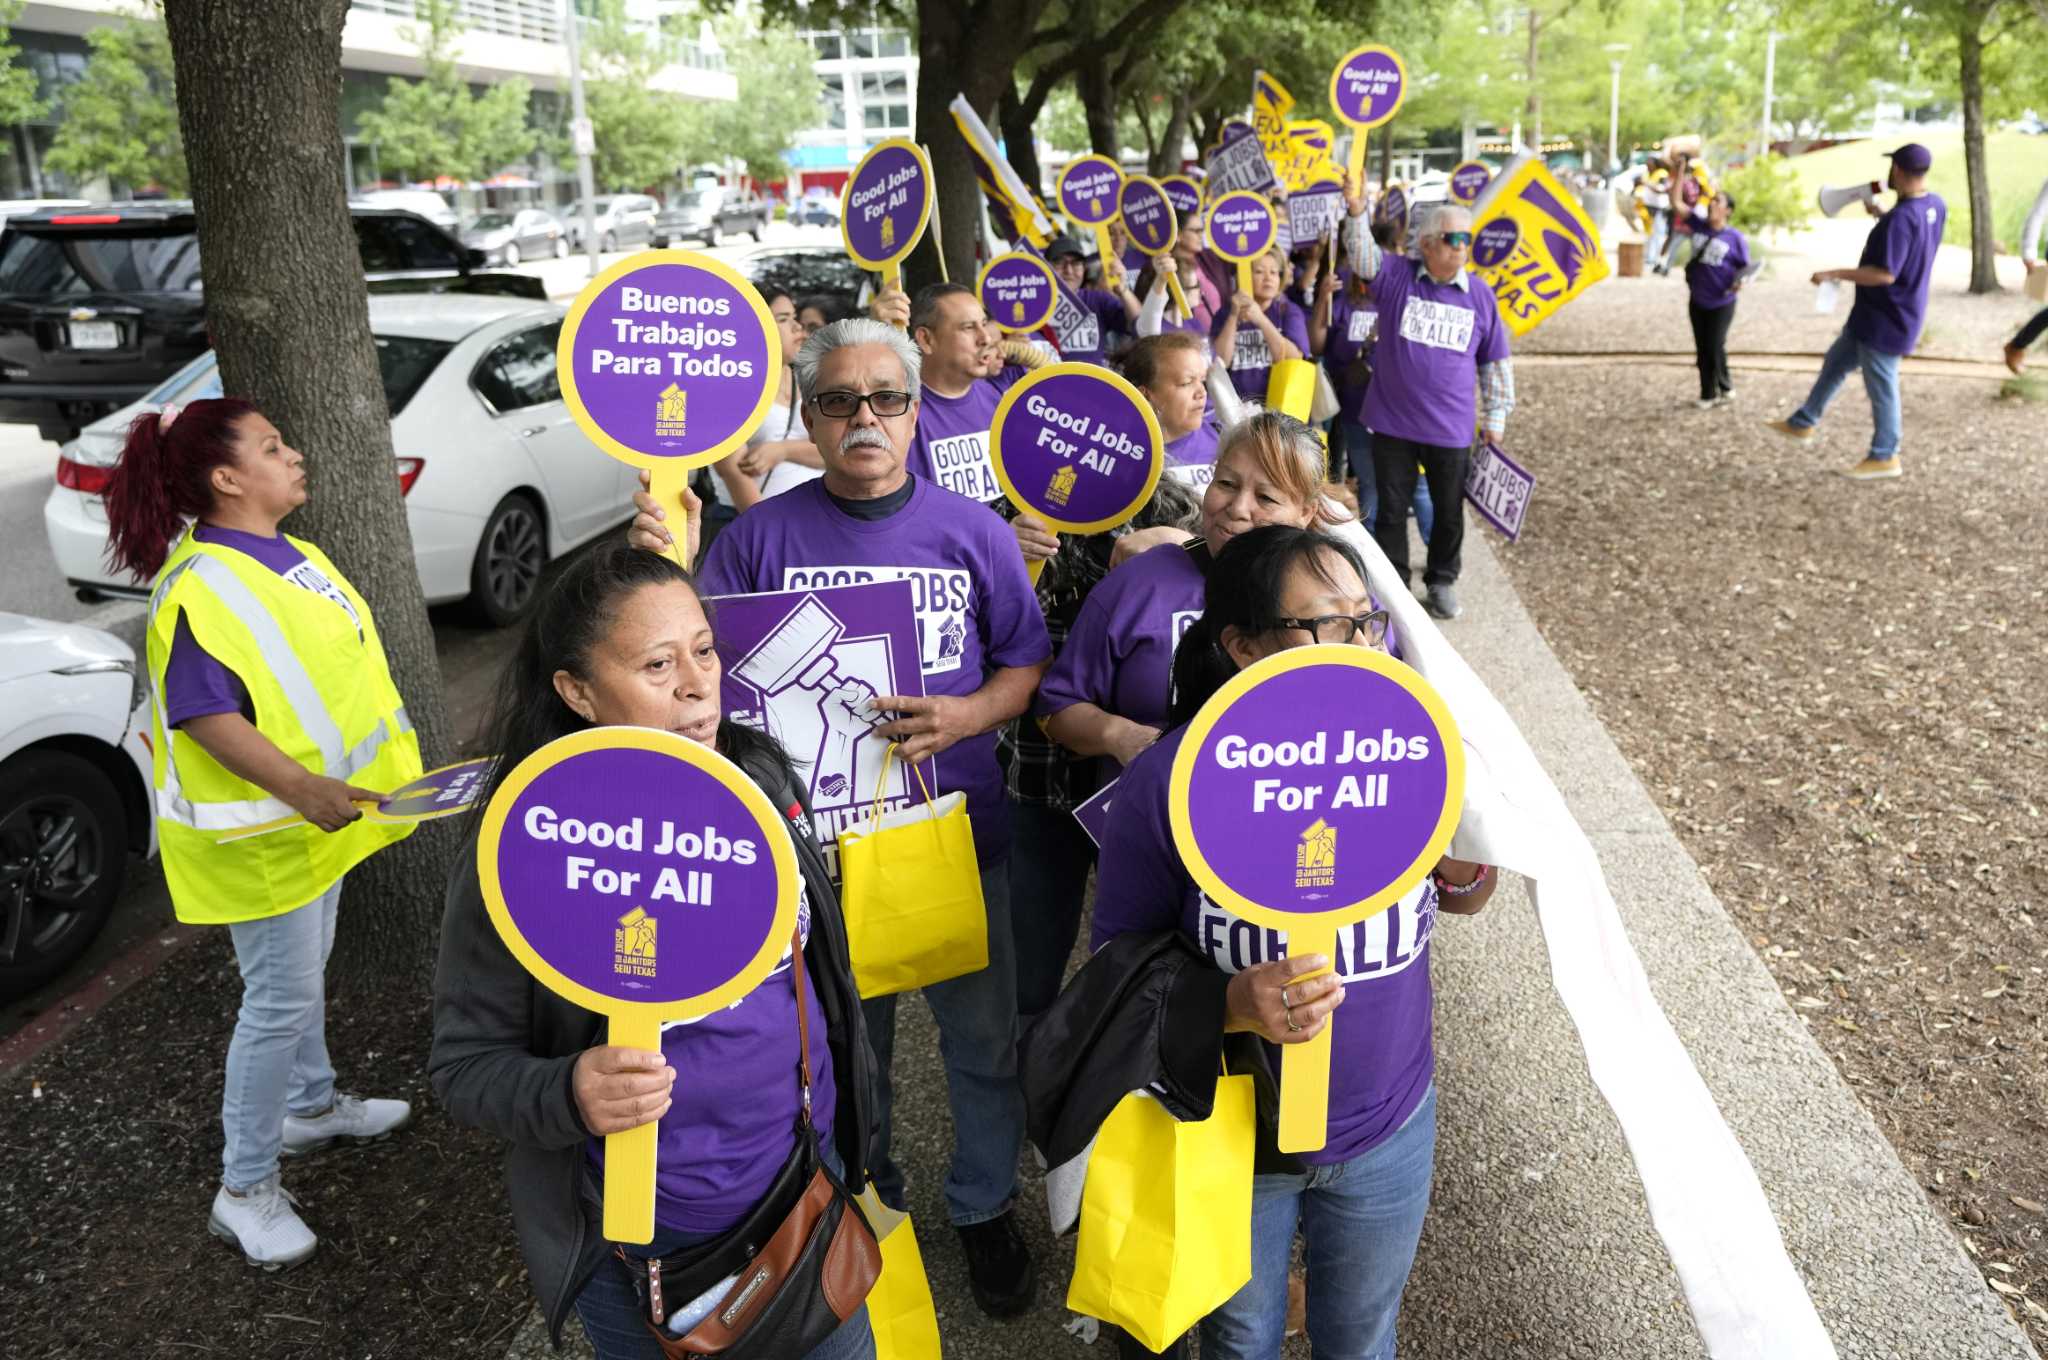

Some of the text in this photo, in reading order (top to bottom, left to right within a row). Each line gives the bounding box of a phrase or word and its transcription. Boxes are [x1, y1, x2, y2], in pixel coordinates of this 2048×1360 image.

[1343, 67, 1399, 83] Good Jobs
[1350, 81, 1388, 95] For All
[851, 165, 918, 208] Good Jobs
[1064, 172, 1117, 191] Good Jobs
[1075, 184, 1111, 201] For All
[864, 187, 908, 222] For All
[1133, 208, 1160, 224] For All
[1214, 209, 1267, 224] Good Jobs
[1292, 198, 1327, 216] GOOD
[1224, 220, 1259, 234] For All
[1294, 216, 1319, 234] FOR
[986, 274, 1047, 288] Good Jobs
[998, 288, 1037, 301] For All
[621, 286, 731, 316] Buenos
[611, 318, 737, 350] Trabajos
[1426, 323, 1454, 346] ALL
[592, 349, 753, 378] Para Todos
[1026, 394, 1146, 462] Good Jobs
[935, 438, 983, 468] GOOD
[1036, 427, 1116, 478] For All
[941, 468, 979, 495] FOR
[1490, 463, 1527, 502] JOBS
[1474, 476, 1501, 518] ALL
[897, 571, 968, 613] OBS
[1214, 729, 1429, 769] Good Jobs
[1252, 774, 1388, 813] For All
[524, 805, 643, 852] Good
[654, 821, 757, 865] Jobs
[566, 856, 712, 906] For All
[1312, 876, 1335, 887] TEXAS
[614, 964, 656, 978] SEIU TEXAS
